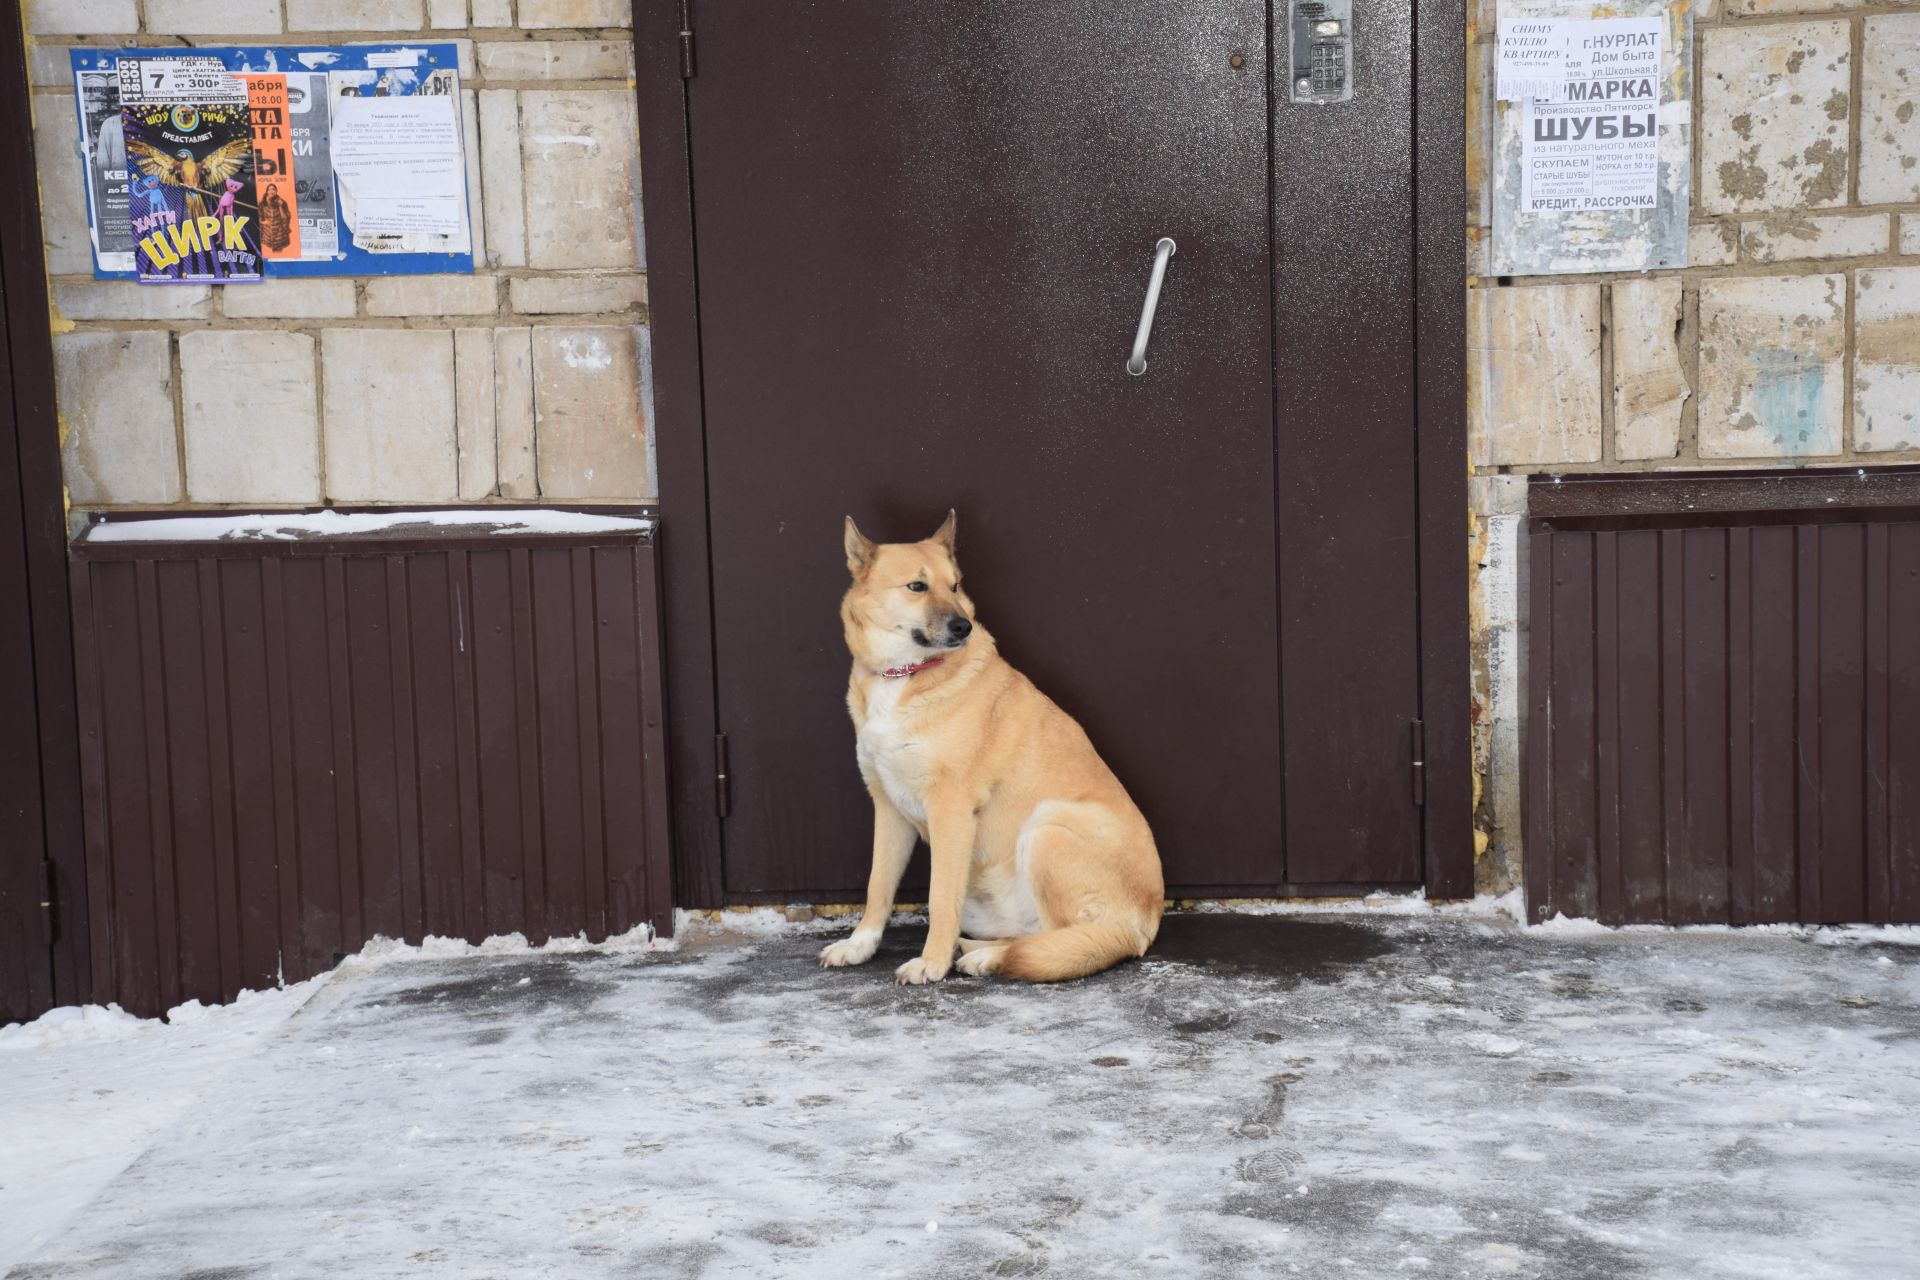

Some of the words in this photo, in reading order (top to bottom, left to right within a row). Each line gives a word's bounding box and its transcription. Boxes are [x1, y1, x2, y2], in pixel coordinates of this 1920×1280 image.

[1512, 25, 1553, 33] СНИМУ
[1504, 37, 1547, 46] КУПЛЮ
[1583, 32, 1658, 49] г.НУРЛАТ
[1503, 50, 1561, 59] КВАРТИРУ
[1591, 51, 1618, 64] Дом
[1622, 50, 1655, 61] быта
[1592, 64, 1658, 79] ул.Школьная,8
[120, 60, 132, 100] 15:00
[129, 60, 142, 100] 18:00
[149, 73, 165, 89] 7
[248, 80, 283, 92] абря
[1535, 79, 1653, 102] МАРКА
[1534, 105, 1602, 116] Производство
[1604, 103, 1654, 113] Пятигорск
[145, 111, 169, 126] ШОУ
[202, 112, 227, 124] РИЧИ
[1534, 113, 1656, 142] ШУБЫ
[162, 131, 213, 144] ПРЕДСТАВЛЯЕТ
[1549, 142, 1625, 154] натурального
[1628, 140, 1656, 149] меха
[1533, 159, 1589, 168] СКУПАЕМ
[1533, 172, 1565, 180] СТАРЫЕ
[1566, 171, 1591, 179] ШУБЫ
[1531, 198, 1581, 211] КРЕДИТ,
[1584, 195, 1654, 208] РАССРОЧКА
[132, 210, 176, 234] ХАГГИ
[140, 215, 250, 270] ЦИРК
[218, 250, 256, 266] ВАГГИ
